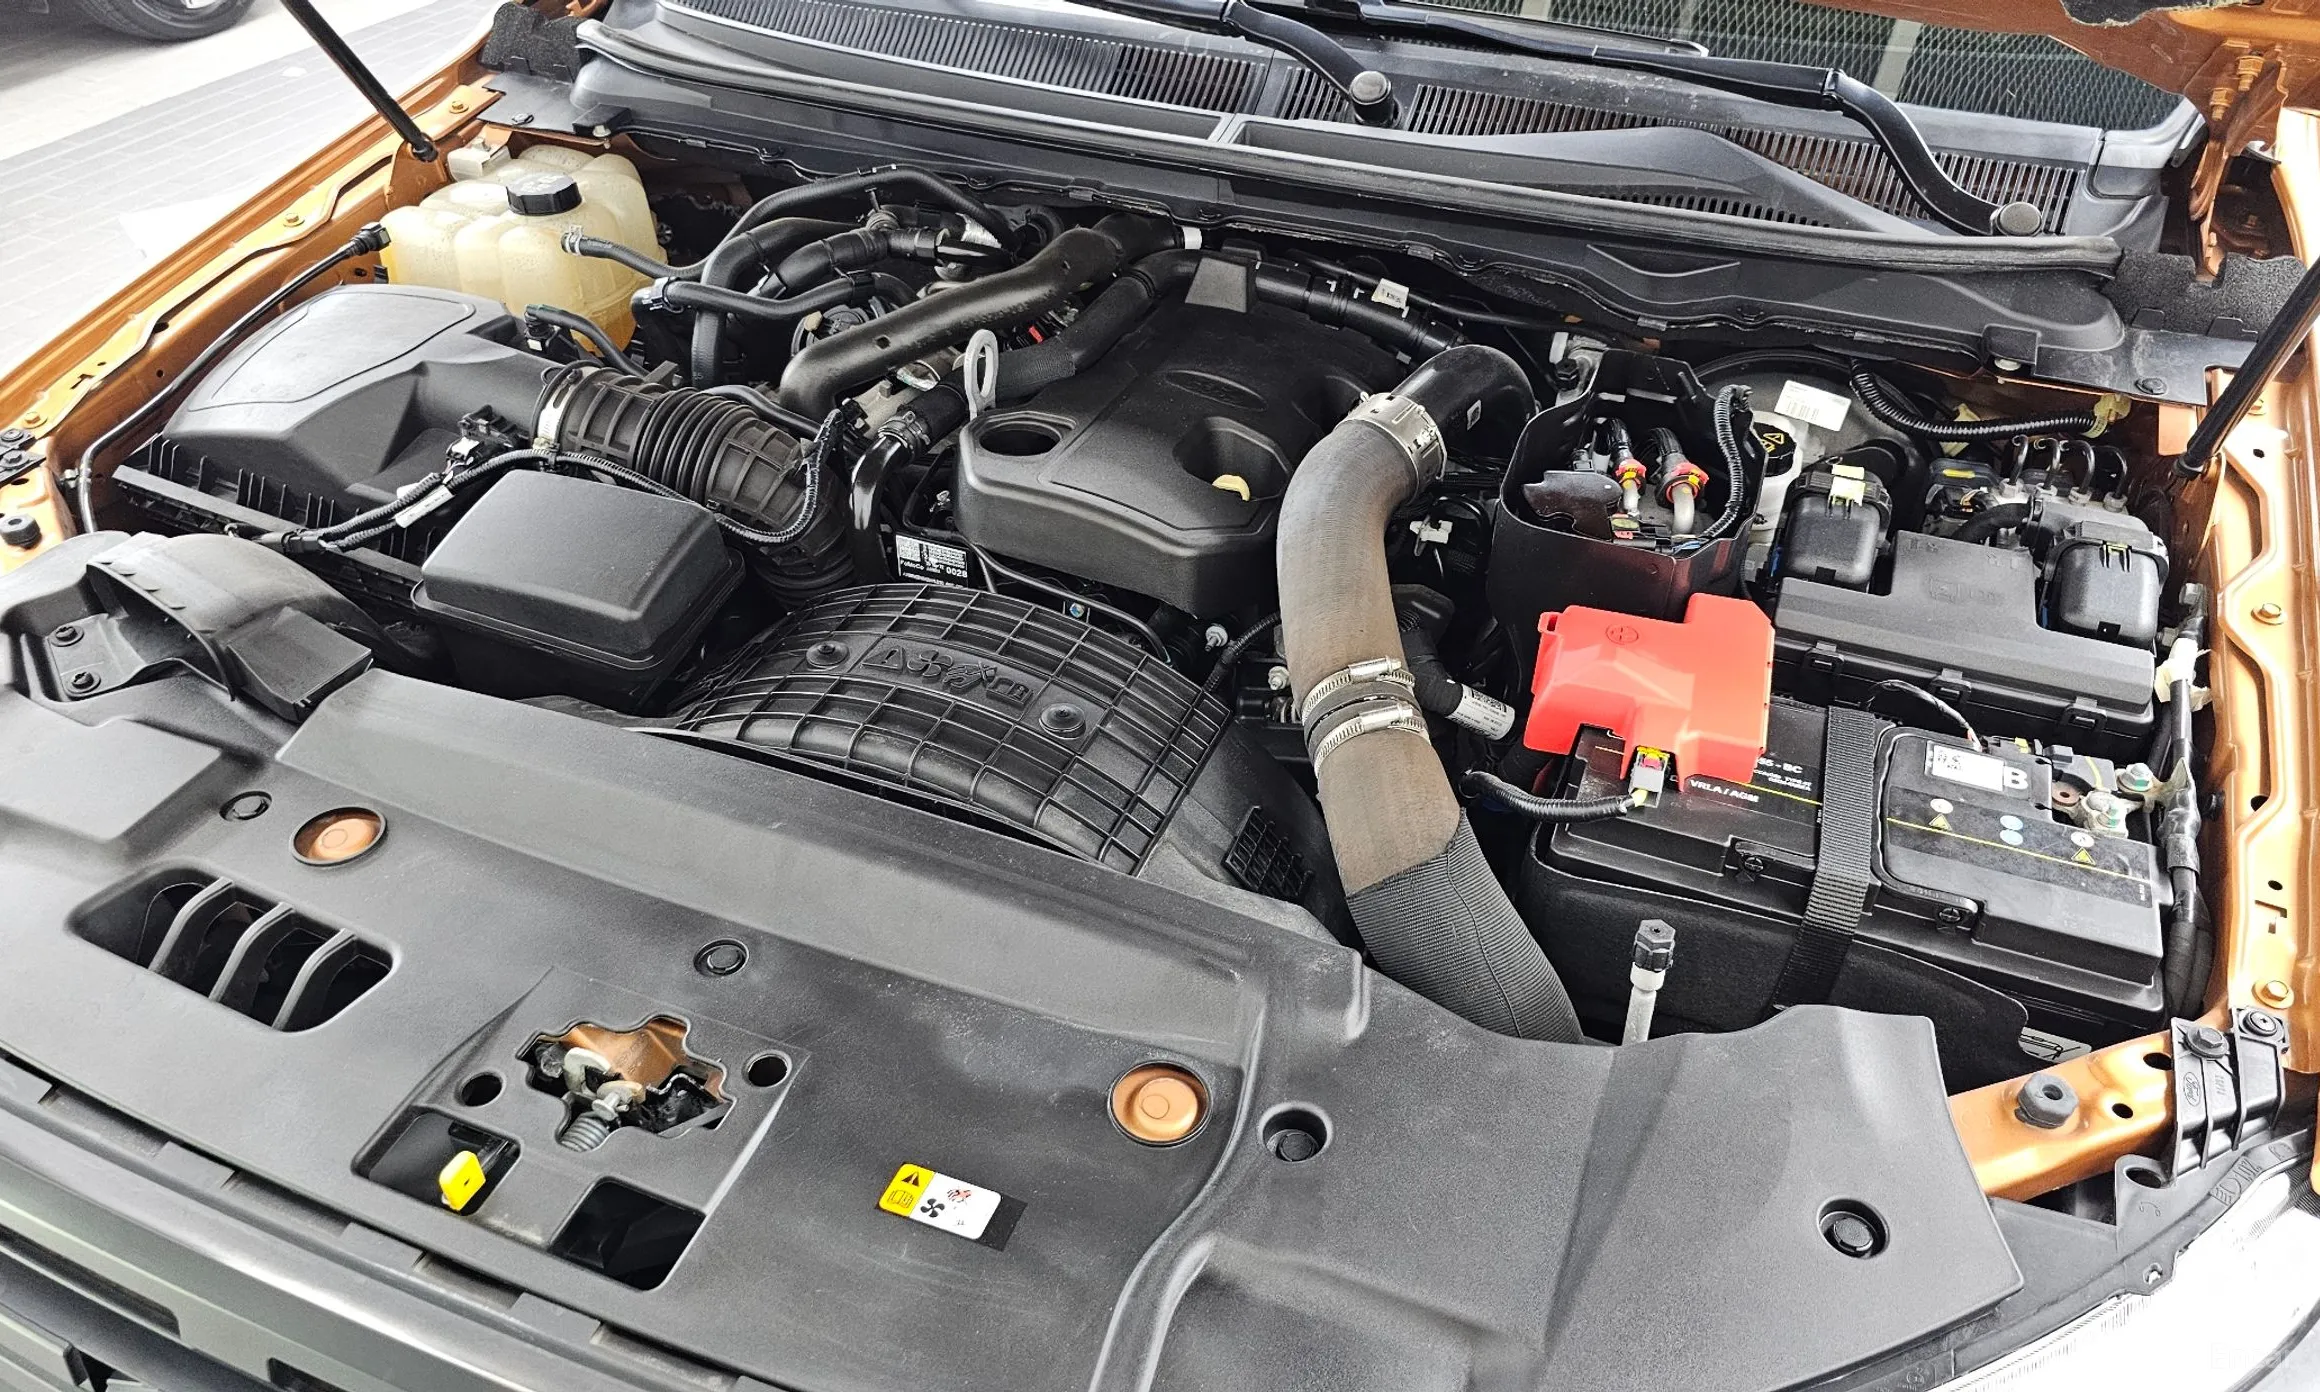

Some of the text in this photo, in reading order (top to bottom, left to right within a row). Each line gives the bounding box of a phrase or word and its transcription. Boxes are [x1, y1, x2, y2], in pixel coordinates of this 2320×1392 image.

[2004, 765, 2029, 790] B
[1690, 779, 1723, 795] VRLA
[1730, 790, 1760, 803] AGM
